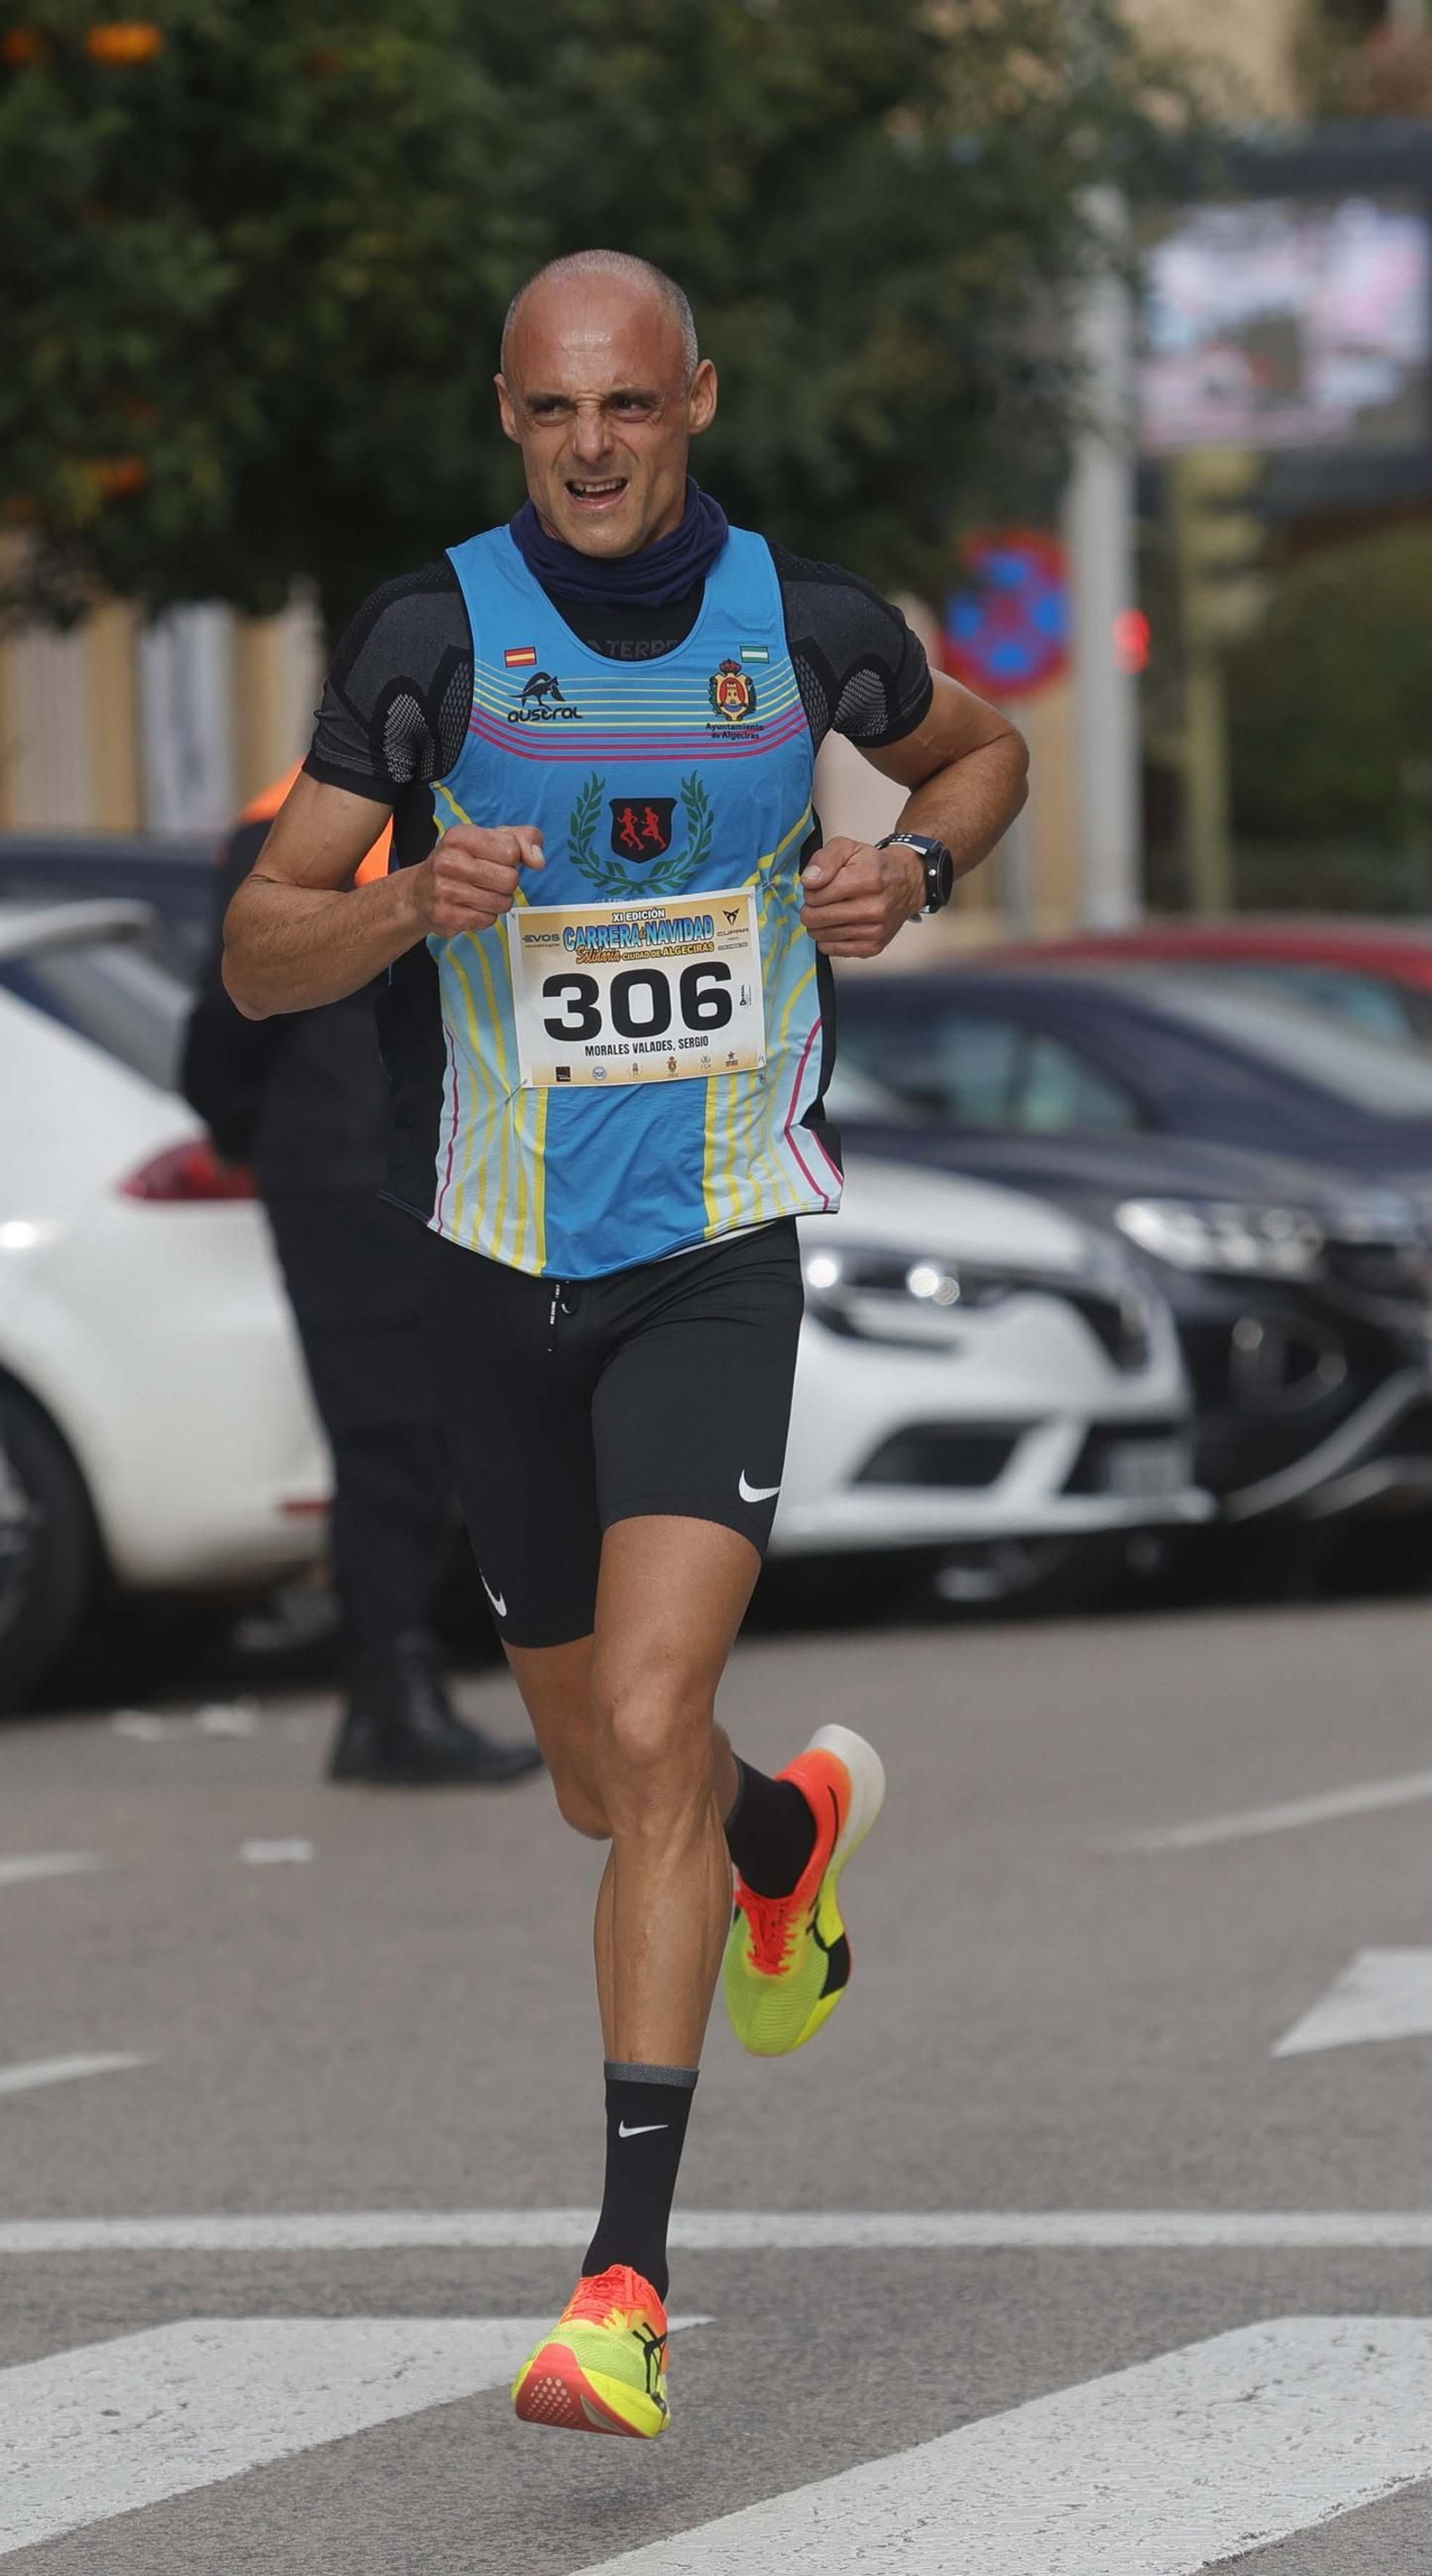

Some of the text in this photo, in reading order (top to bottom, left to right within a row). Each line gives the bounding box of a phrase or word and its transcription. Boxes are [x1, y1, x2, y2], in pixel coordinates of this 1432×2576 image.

[507, 707, 583, 723] austral
[705, 723, 764, 732] Ayuntamiento
[721, 731, 760, 741] Algeciras
[612, 907, 666, 923] XI EDICIÓN
[523, 933, 561, 943] EVOS
[563, 922, 642, 951] CARRERA
[645, 914, 714, 946] NAVIDAD
[576, 945, 621, 964] Solidaria
[622, 950, 650, 961] CIUDAD
[652, 949, 662, 958] DE
[662, 942, 714, 956] ALGECIRAS
[542, 961, 732, 1041] 306
[585, 1035, 709, 1057] MORALES VALADES, SERGIO
